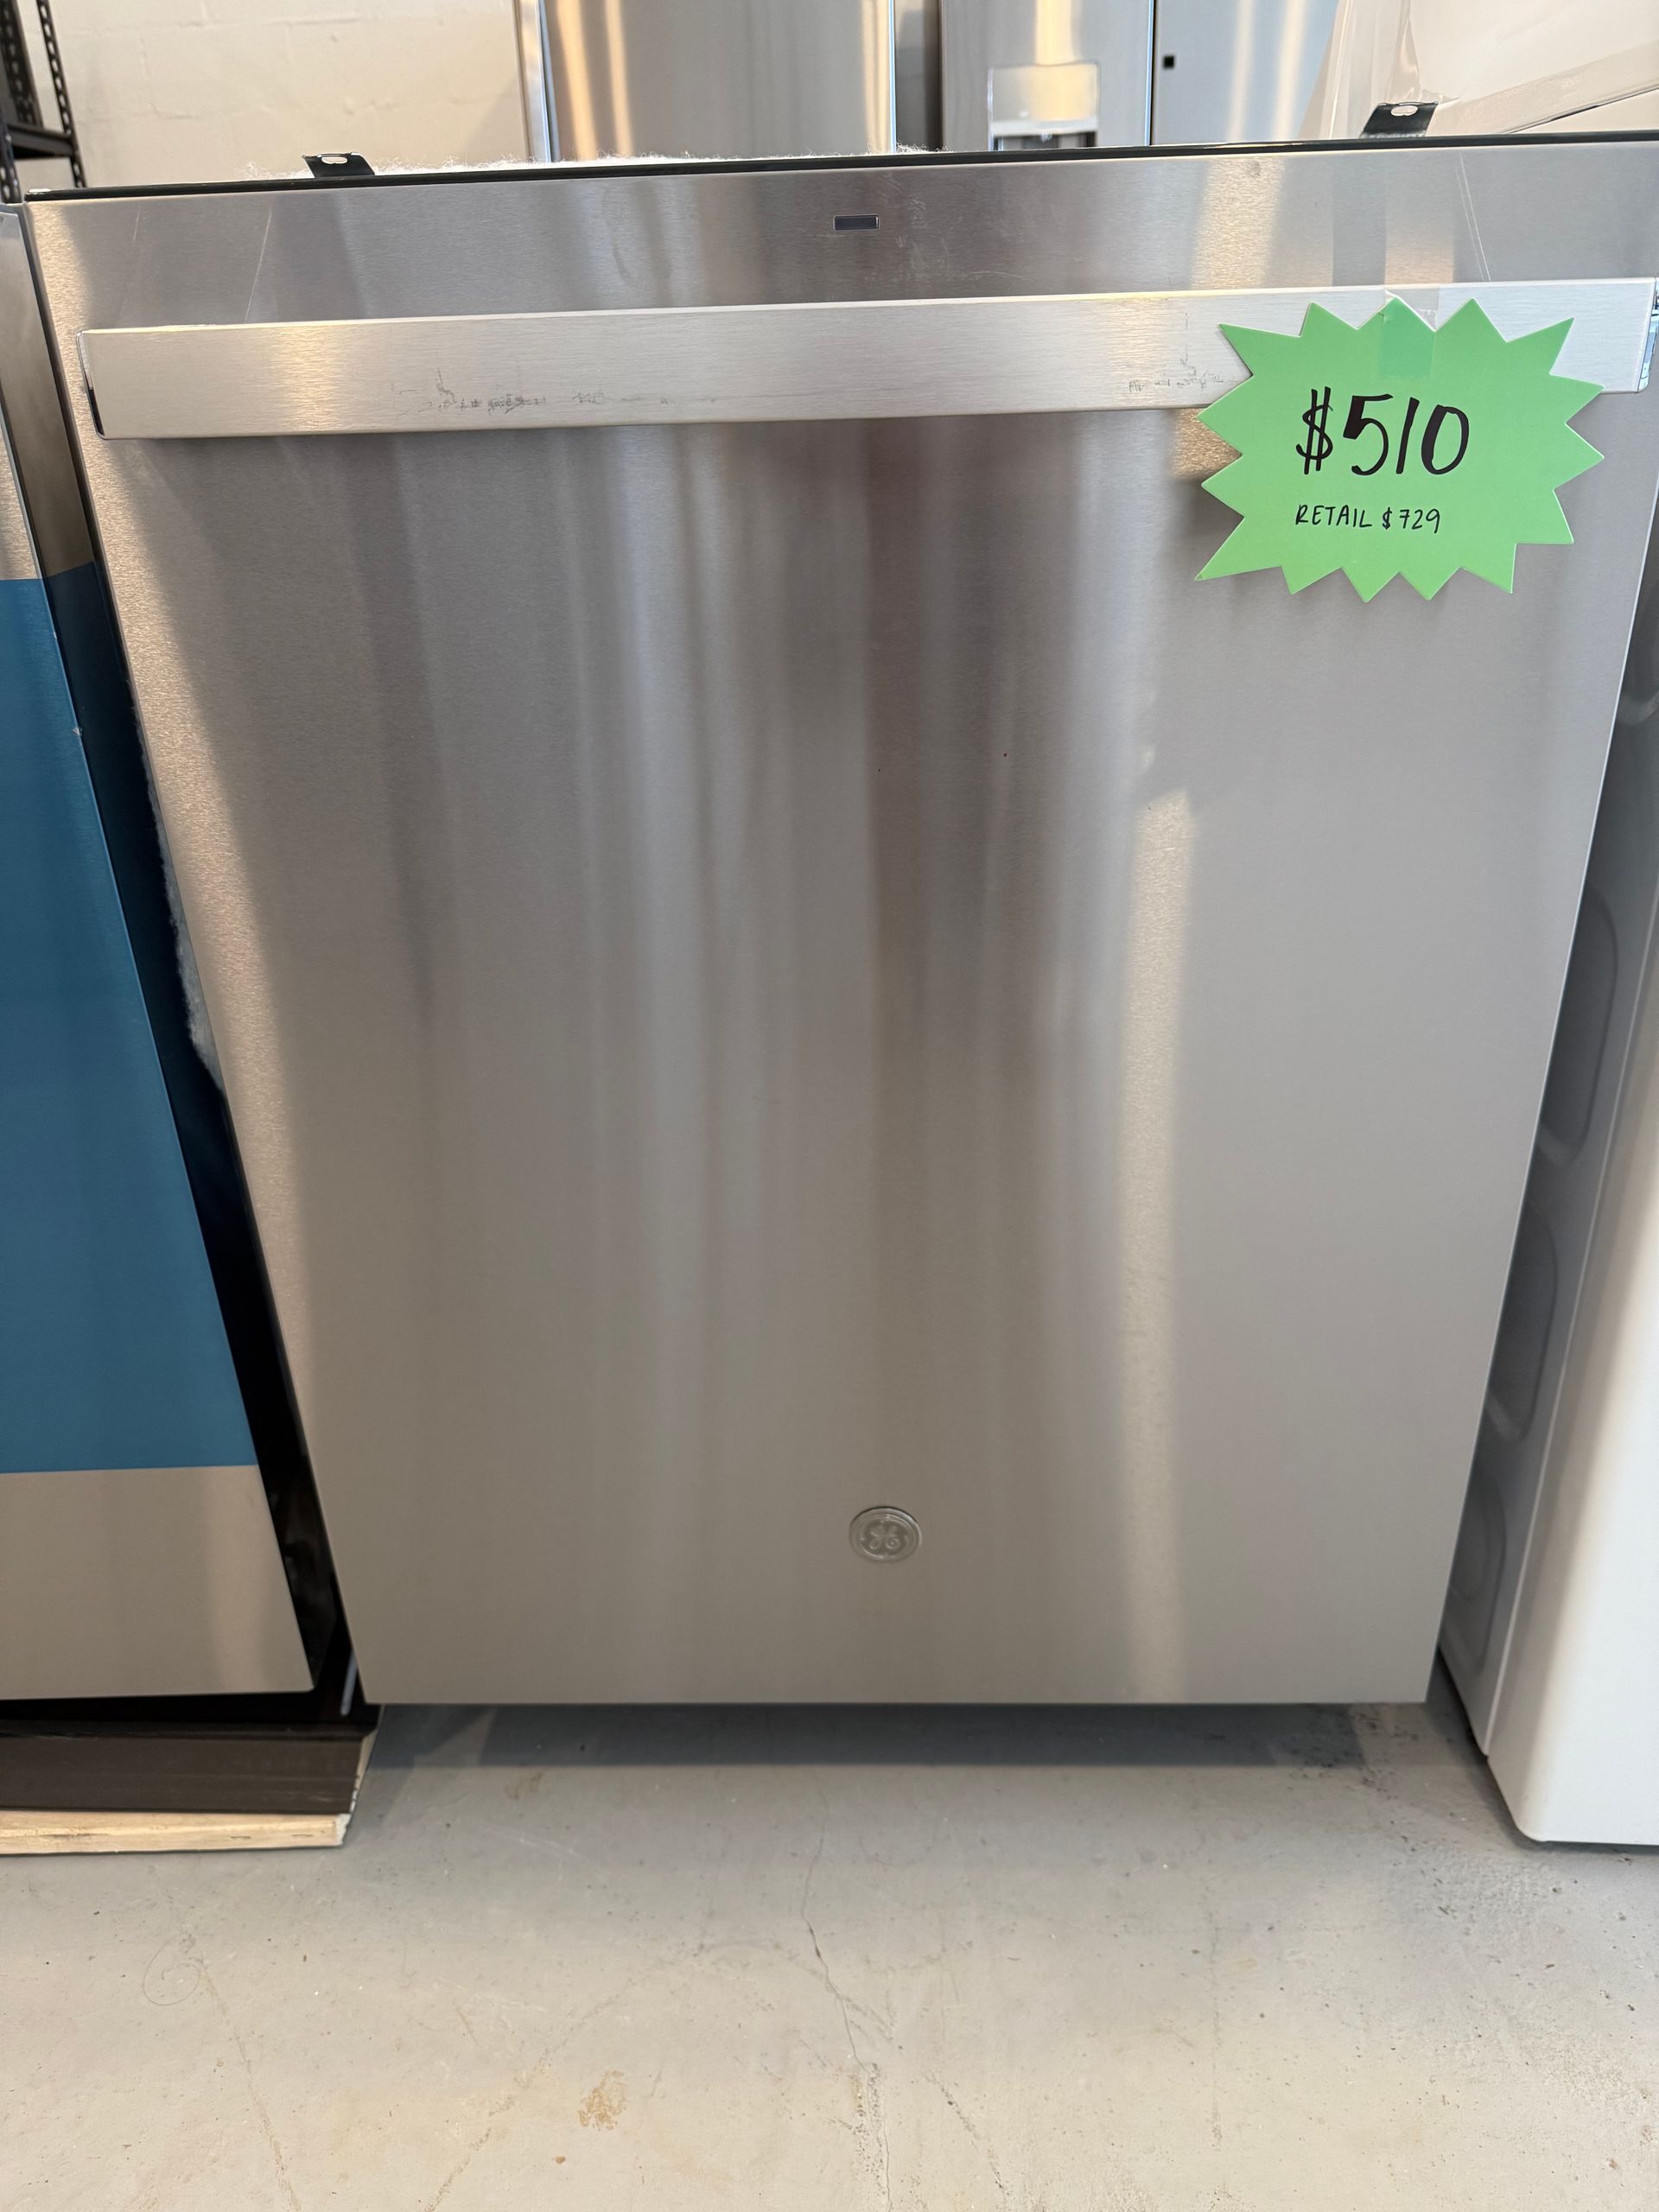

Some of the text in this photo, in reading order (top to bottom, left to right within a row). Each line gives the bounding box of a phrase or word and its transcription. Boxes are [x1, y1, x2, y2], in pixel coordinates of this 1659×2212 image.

[1296, 386, 1469, 475] $510
[1295, 505, 1440, 534] RETAIL $729
